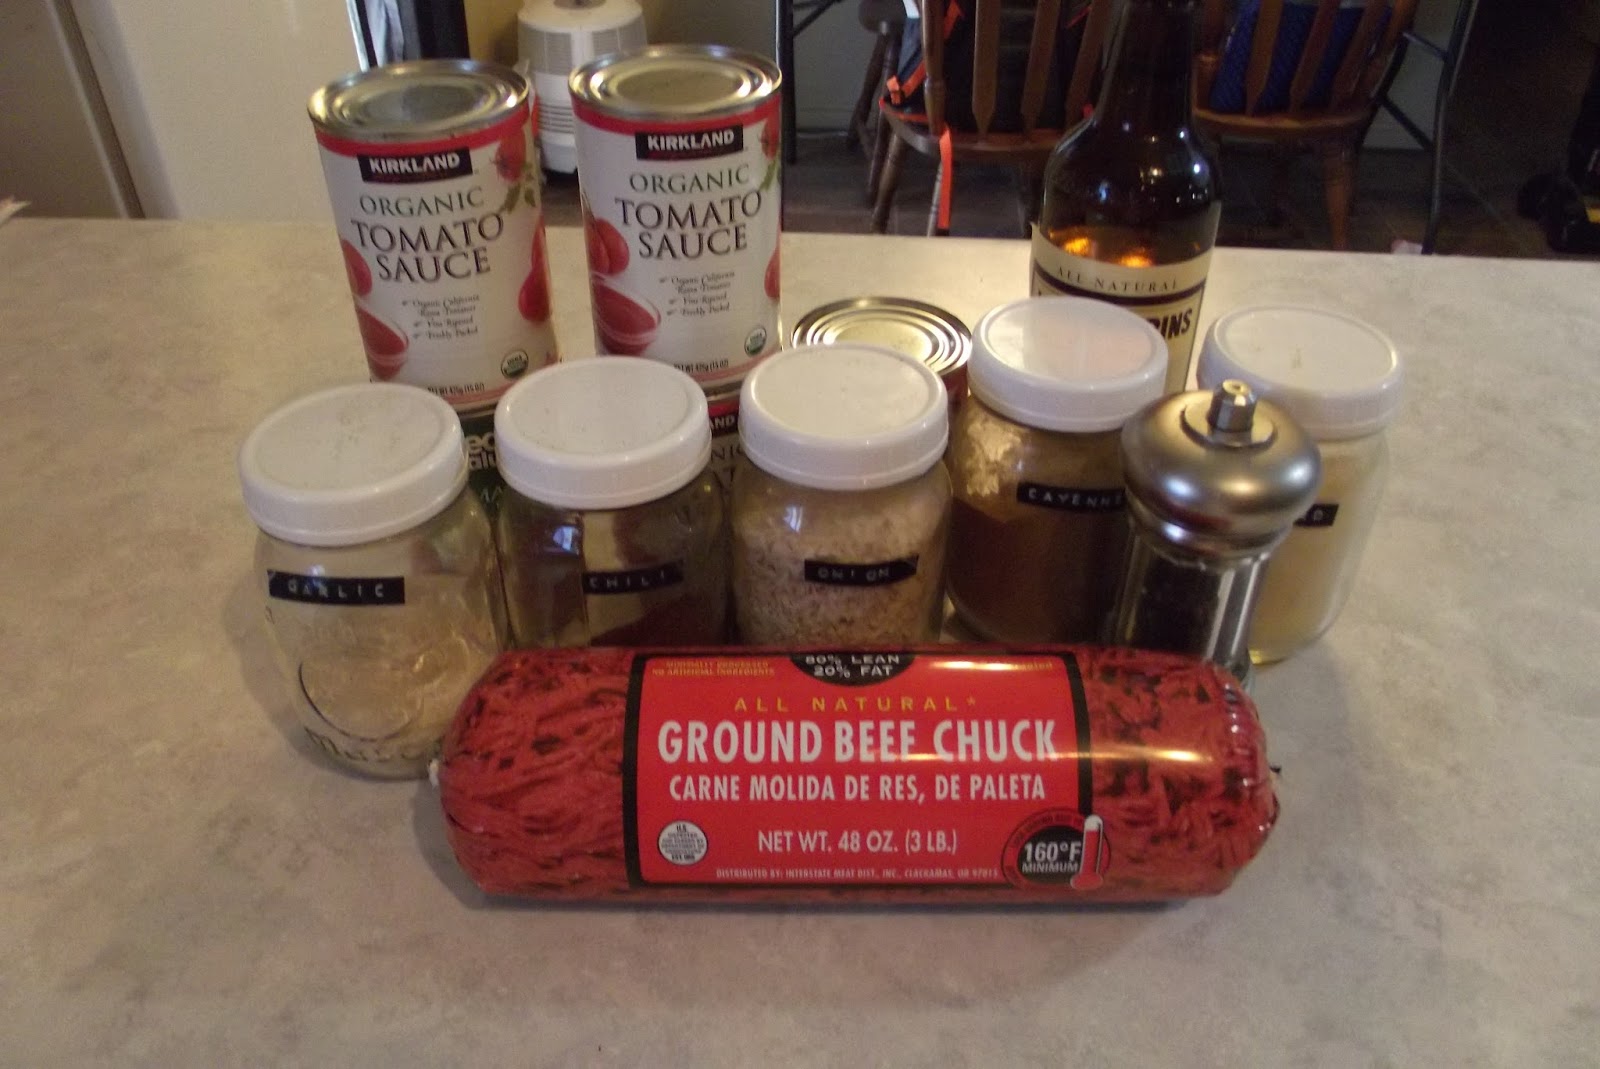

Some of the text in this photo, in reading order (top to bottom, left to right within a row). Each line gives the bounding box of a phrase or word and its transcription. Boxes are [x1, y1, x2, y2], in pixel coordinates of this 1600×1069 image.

[647, 129, 735, 151] KIRKLAND
[369, 152, 460, 175] KIRKLAND
[629, 163, 749, 194] ORGANIC
[359, 186, 484, 217] ORGANIC
[614, 190, 762, 231] TOMATO
[350, 212, 503, 254] TOMATO
[638, 224, 748, 260] SAUCE
[376, 246, 491, 284] SAUCE
[1056, 266, 1178, 292] ALL NATURAL
[589, 569, 665, 588] CHILI
[817, 566, 890, 582] ONION
[288, 579, 384, 598] GARLIC
[806, 653, 900, 666] 80% LEAN
[814, 664, 893, 679] 20% FAT
[734, 697, 789, 712] ALL
[657, 719, 1058, 764] GROUND BEEF CHUCK
[669, 774, 1046, 805] CARNE MOLIDA DE RES, DE PALETA
[757, 828, 958, 855] NET WT. 48 OZ. (3 LB.)
[716, 867, 768, 879] DISTRIBUTED
[785, 867, 832, 879] INTERSTATE
[833, 867, 855, 879] MEAT
[1021, 862, 1079, 873] MINIMUM
